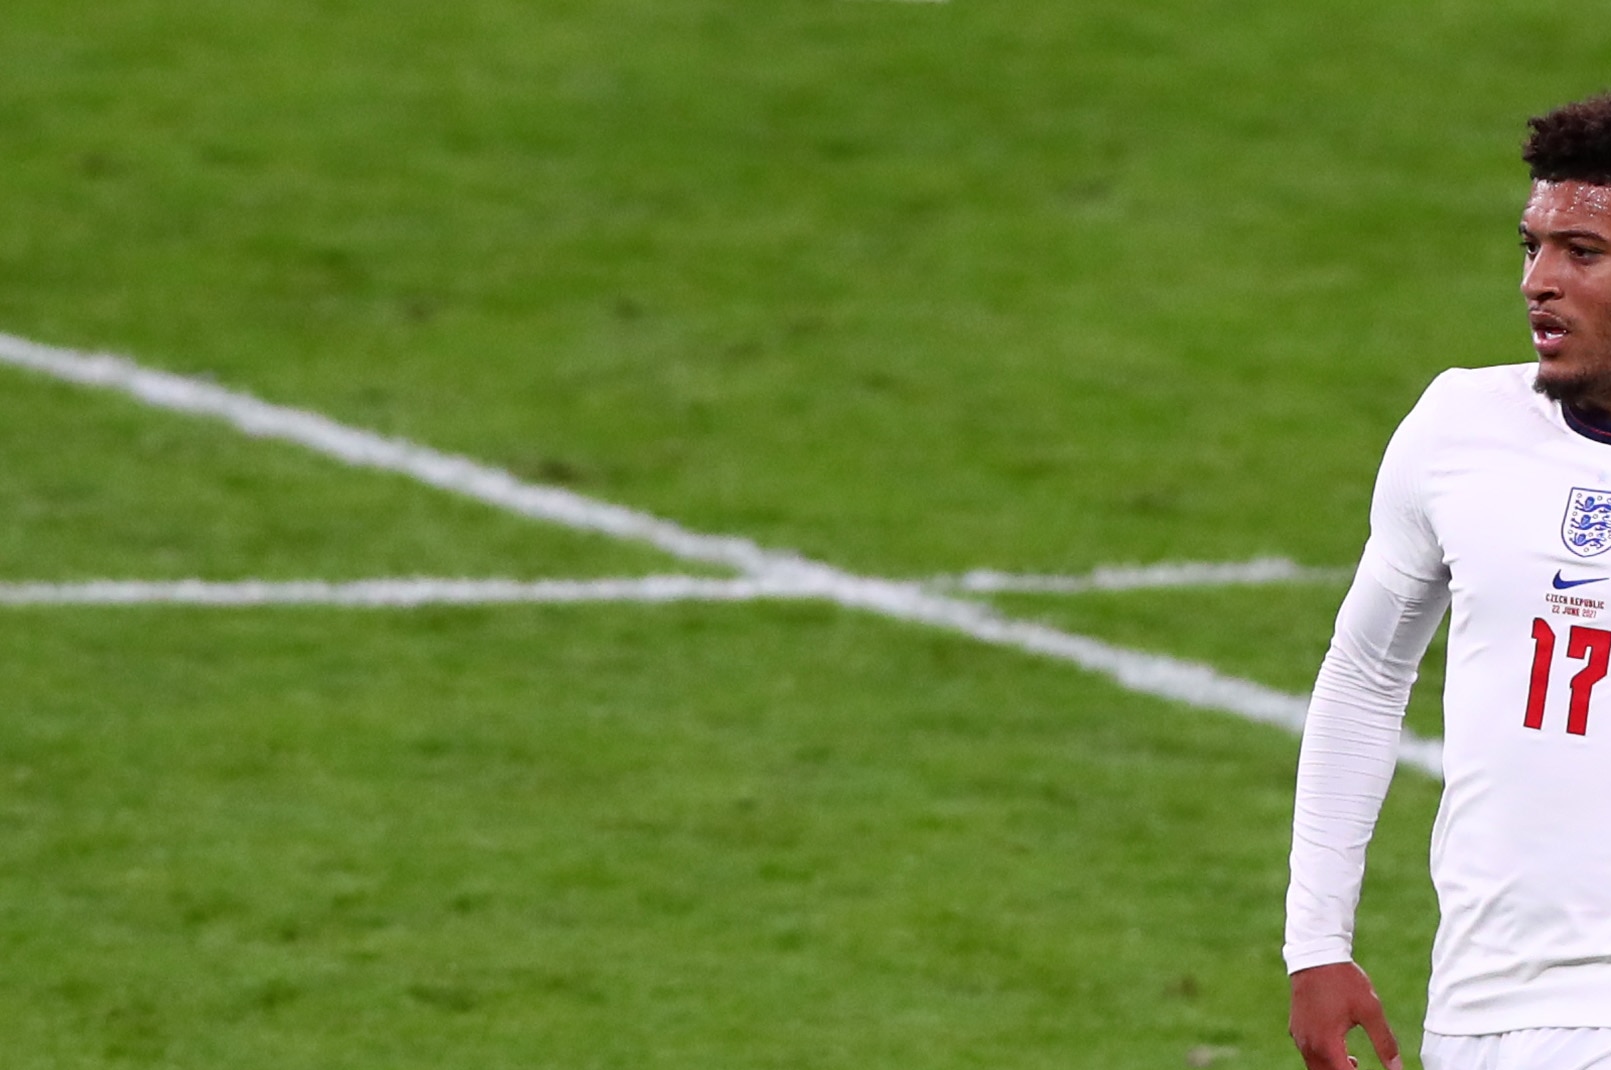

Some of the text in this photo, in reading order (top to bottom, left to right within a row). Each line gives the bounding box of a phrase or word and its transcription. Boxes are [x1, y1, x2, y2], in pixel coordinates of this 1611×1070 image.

[1545, 593, 1604, 609] CZECH REPUBLIC
[1552, 605, 1560, 614] 22
[1562, 606, 1580, 616] JUNE
